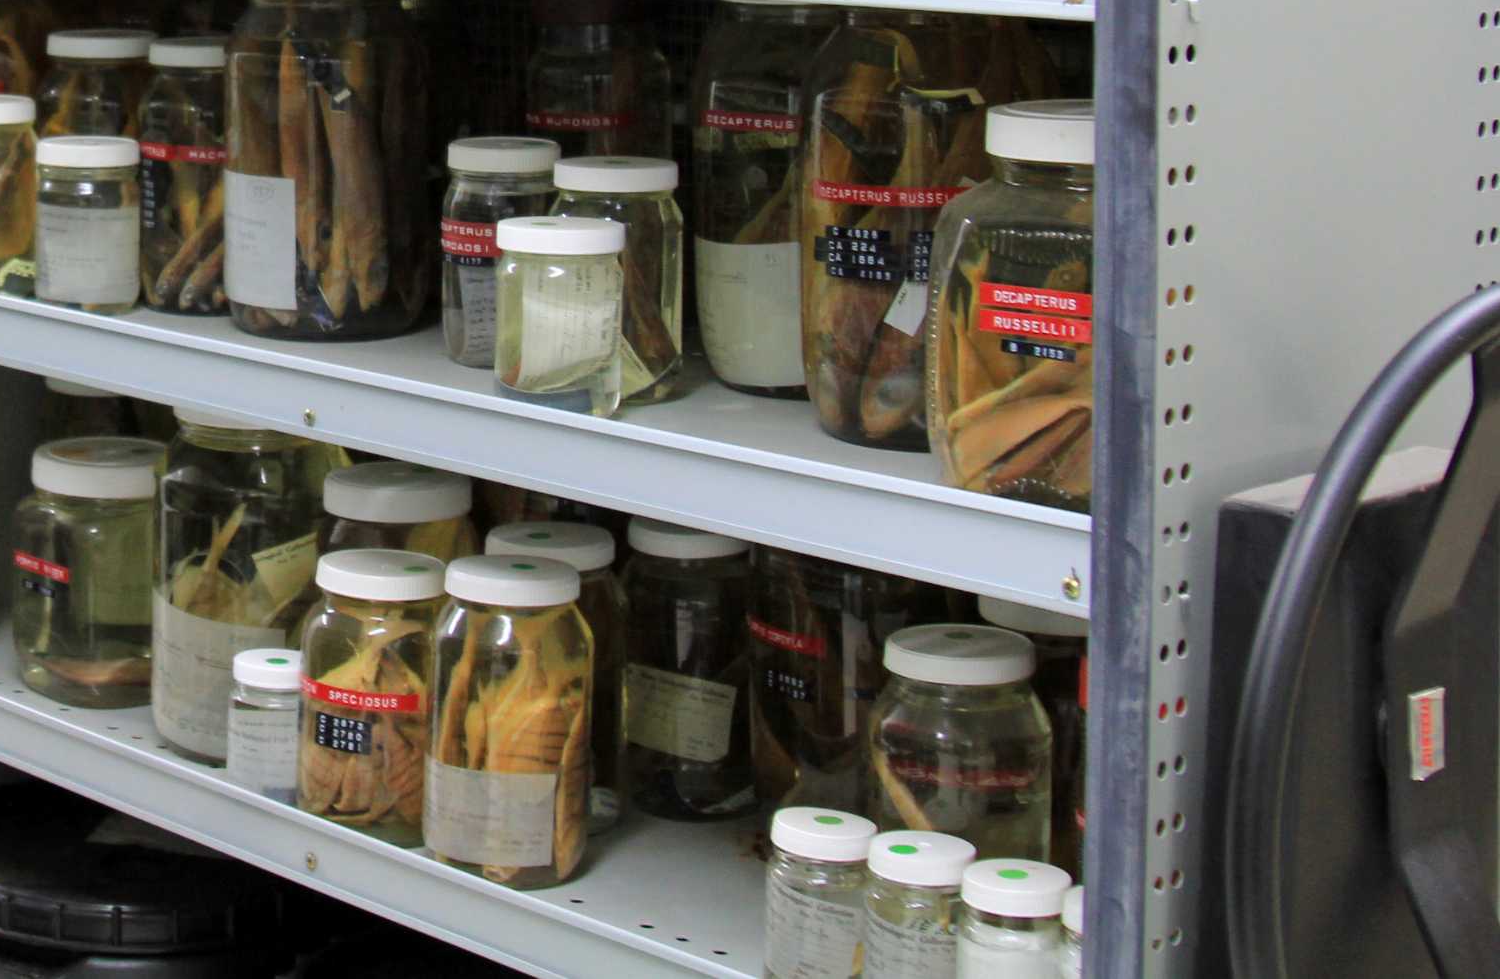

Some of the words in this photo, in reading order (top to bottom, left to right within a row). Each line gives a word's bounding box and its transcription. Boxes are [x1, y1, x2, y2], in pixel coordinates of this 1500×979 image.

[707, 114, 795, 129] DECAPTERUS
[820, 186, 891, 203] DECAPTERUS
[993, 289, 1078, 312] DECAPTERUS
[993, 315, 1077, 337] RUSSELLII
[328, 690, 398, 709] SPECIOSUS
